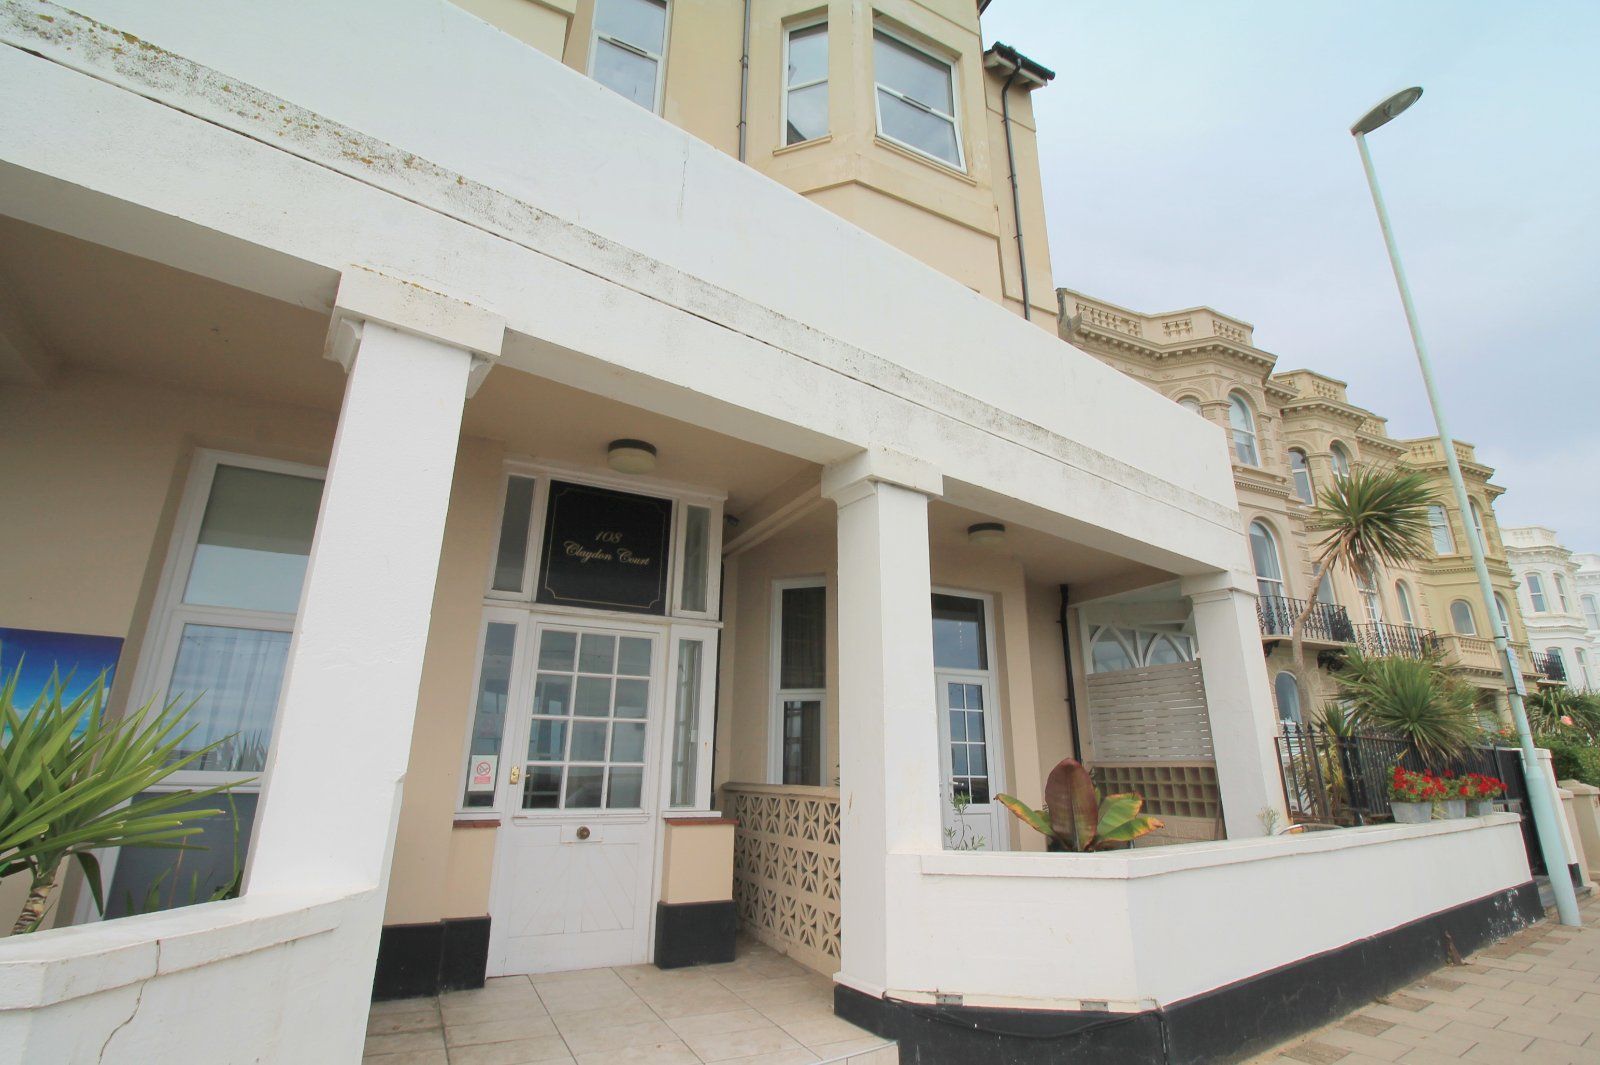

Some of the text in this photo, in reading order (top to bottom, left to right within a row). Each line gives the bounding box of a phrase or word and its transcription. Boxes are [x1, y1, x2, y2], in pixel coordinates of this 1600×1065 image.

[595, 531, 623, 543] 108
[563, 540, 650, 565] Claydon Court
